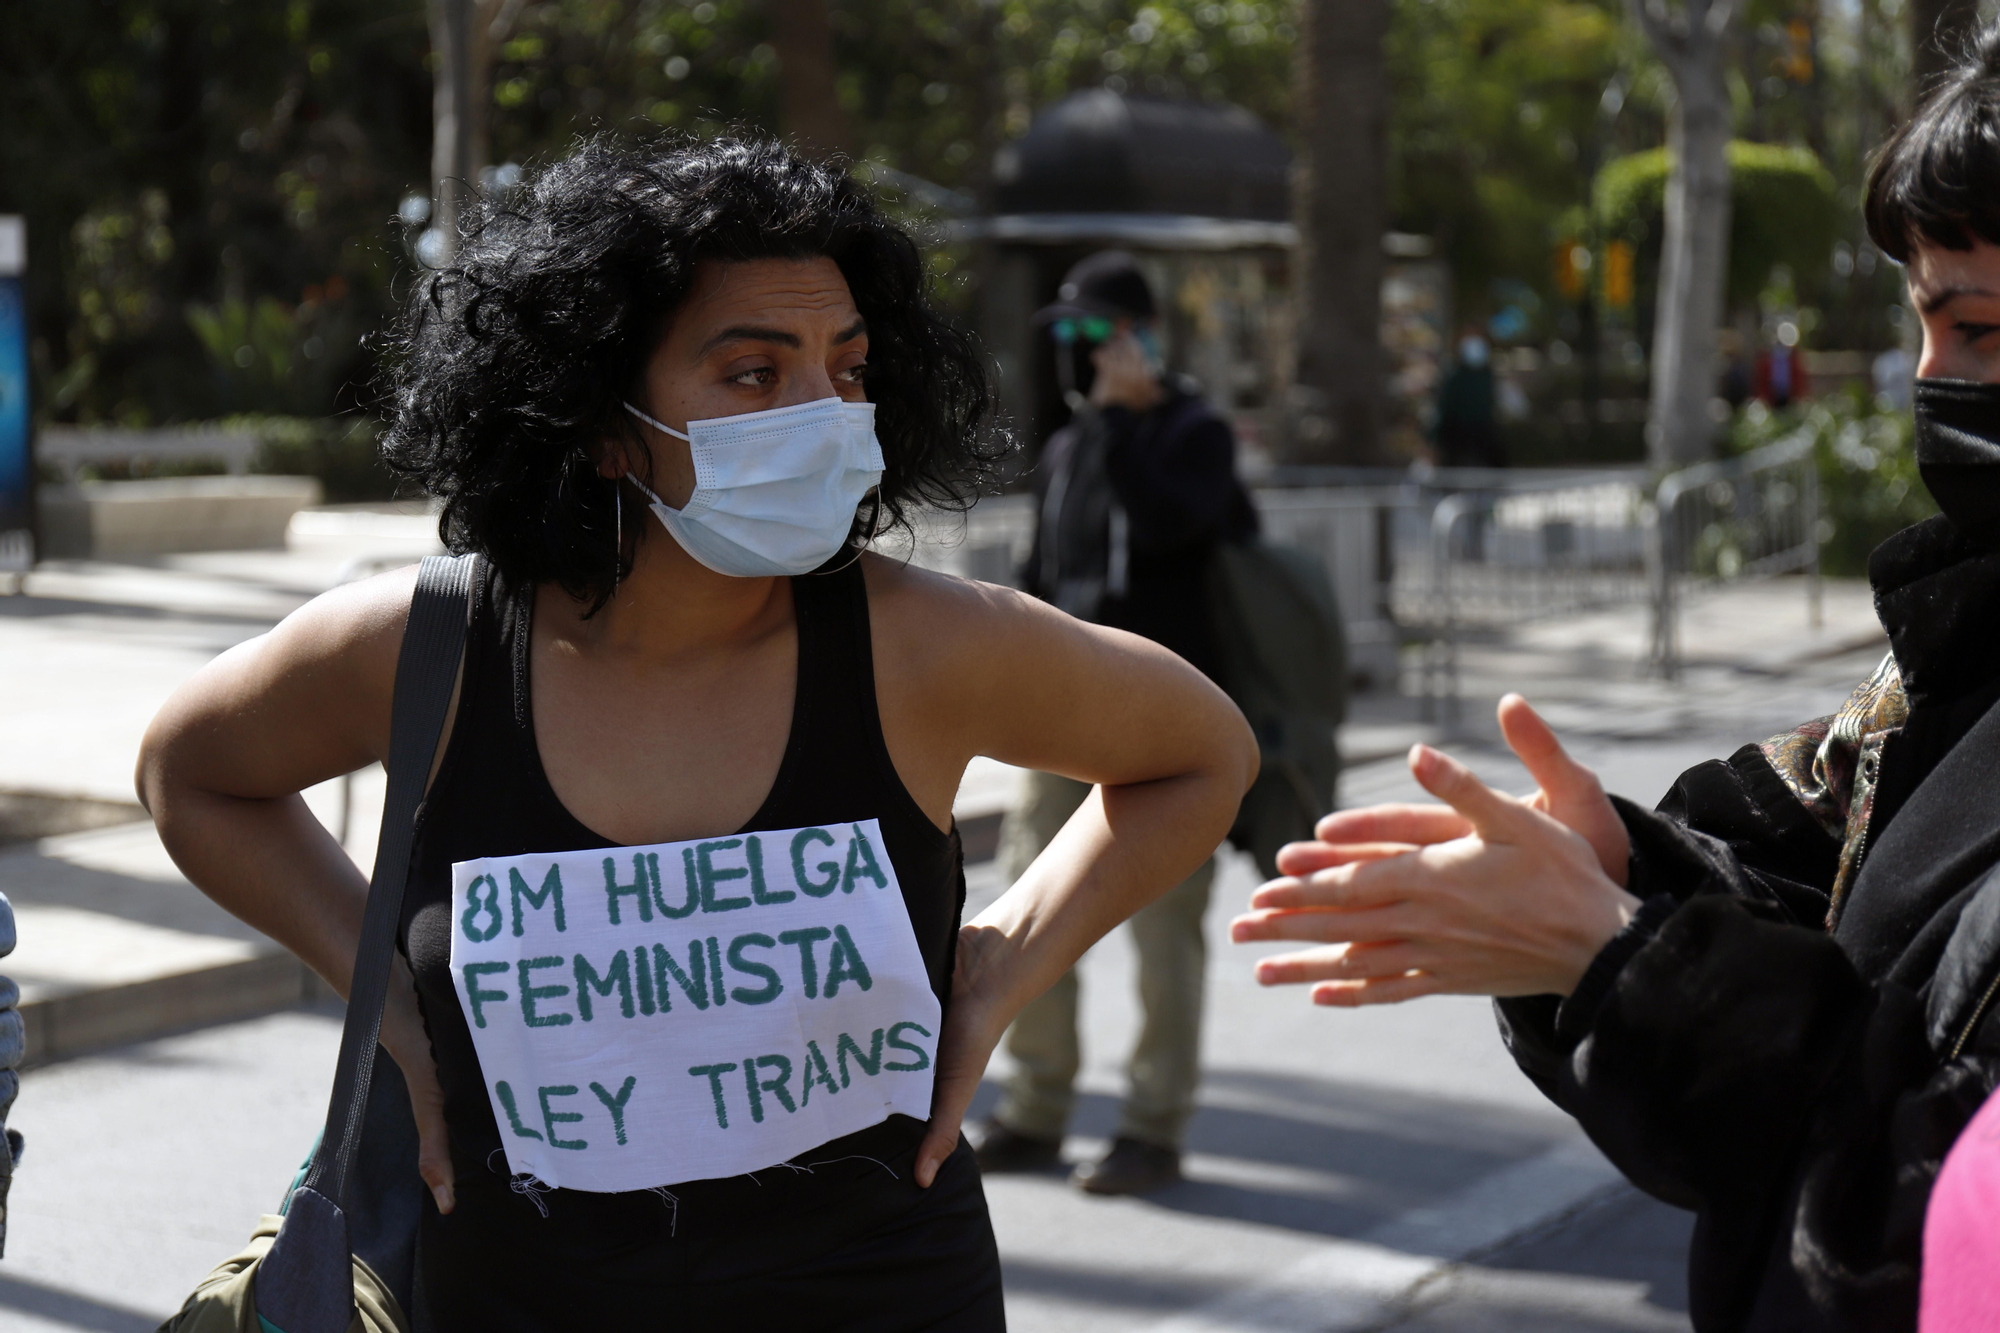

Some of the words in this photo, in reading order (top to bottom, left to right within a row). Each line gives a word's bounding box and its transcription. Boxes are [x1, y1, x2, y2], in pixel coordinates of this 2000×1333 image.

[461, 863, 567, 943] 8M
[602, 823, 889, 925] HUELGA
[462, 924, 873, 1029] FEMINISTA
[495, 1076, 636, 1151] LEY
[688, 1021, 932, 1130] TRANS
